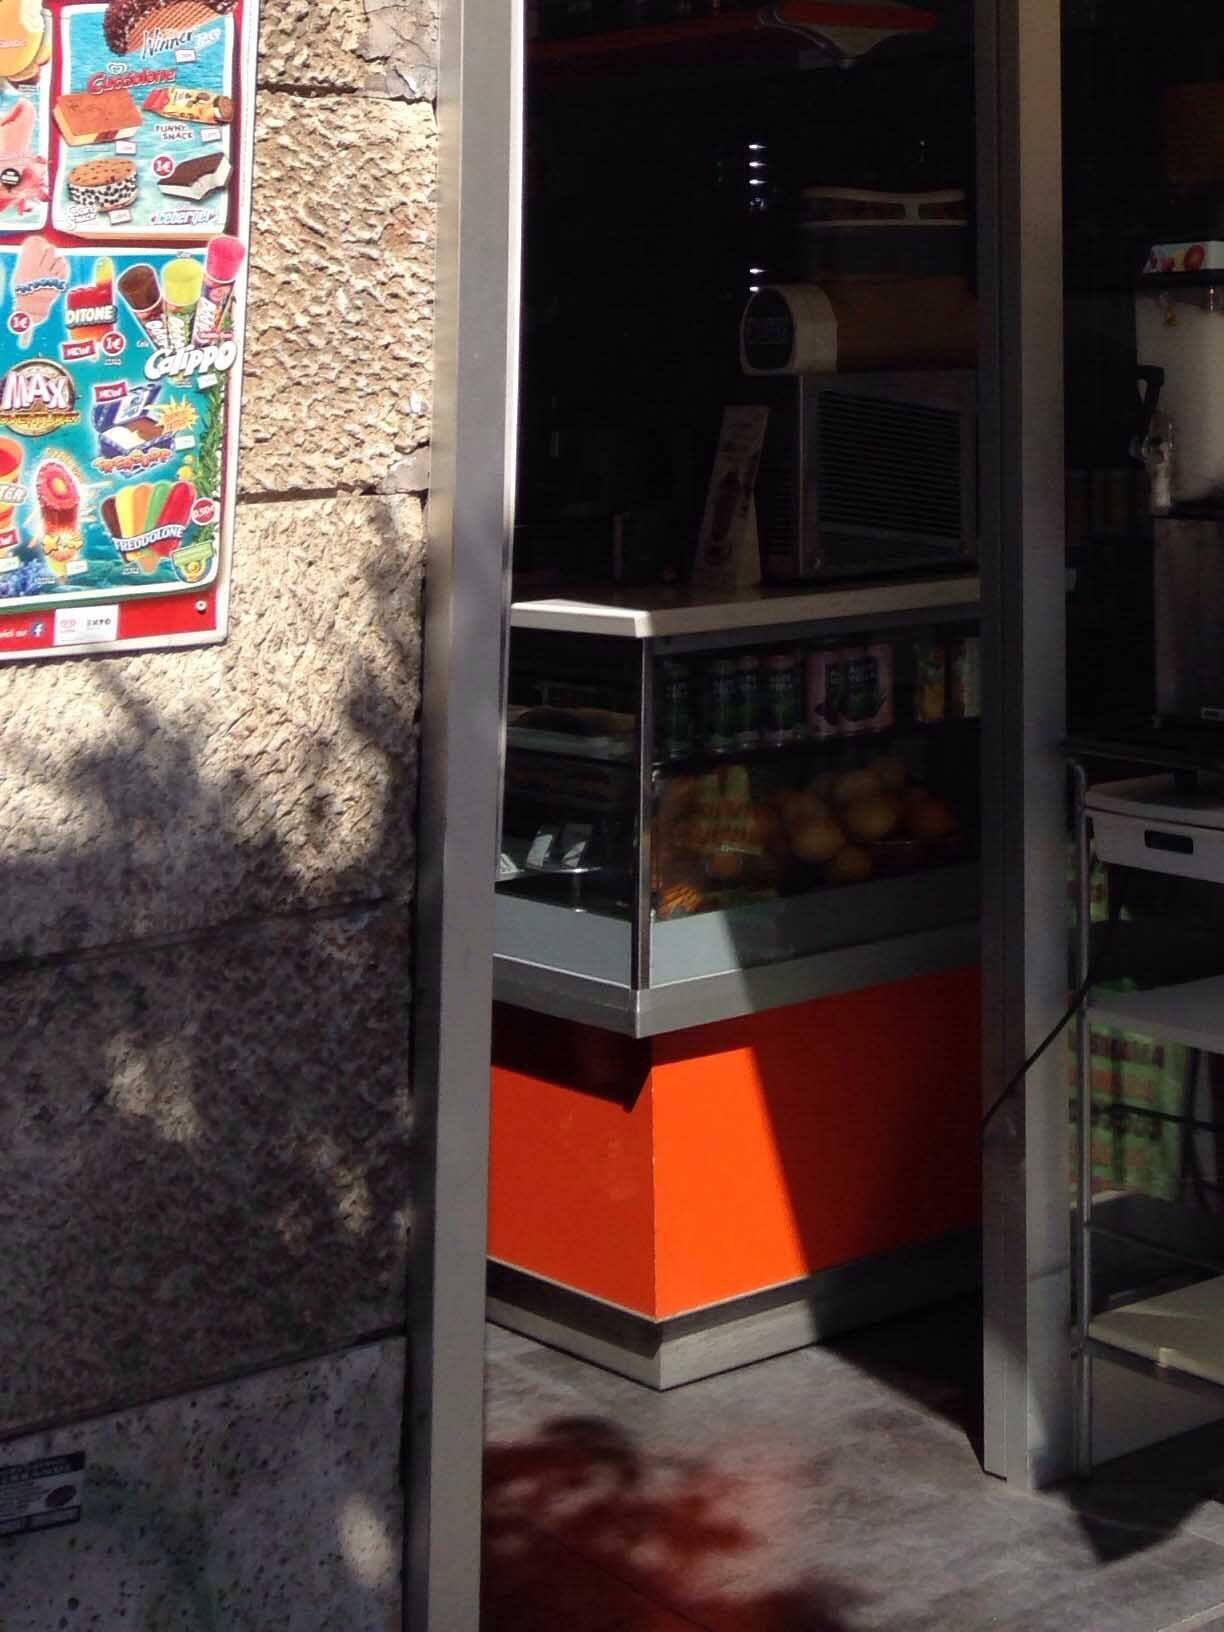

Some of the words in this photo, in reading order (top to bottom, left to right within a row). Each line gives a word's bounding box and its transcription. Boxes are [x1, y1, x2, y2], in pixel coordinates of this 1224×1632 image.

[66, 304, 115, 325] DITONE
[144, 340, 237, 380] Calippo
[2, 370, 68, 411] MAX
